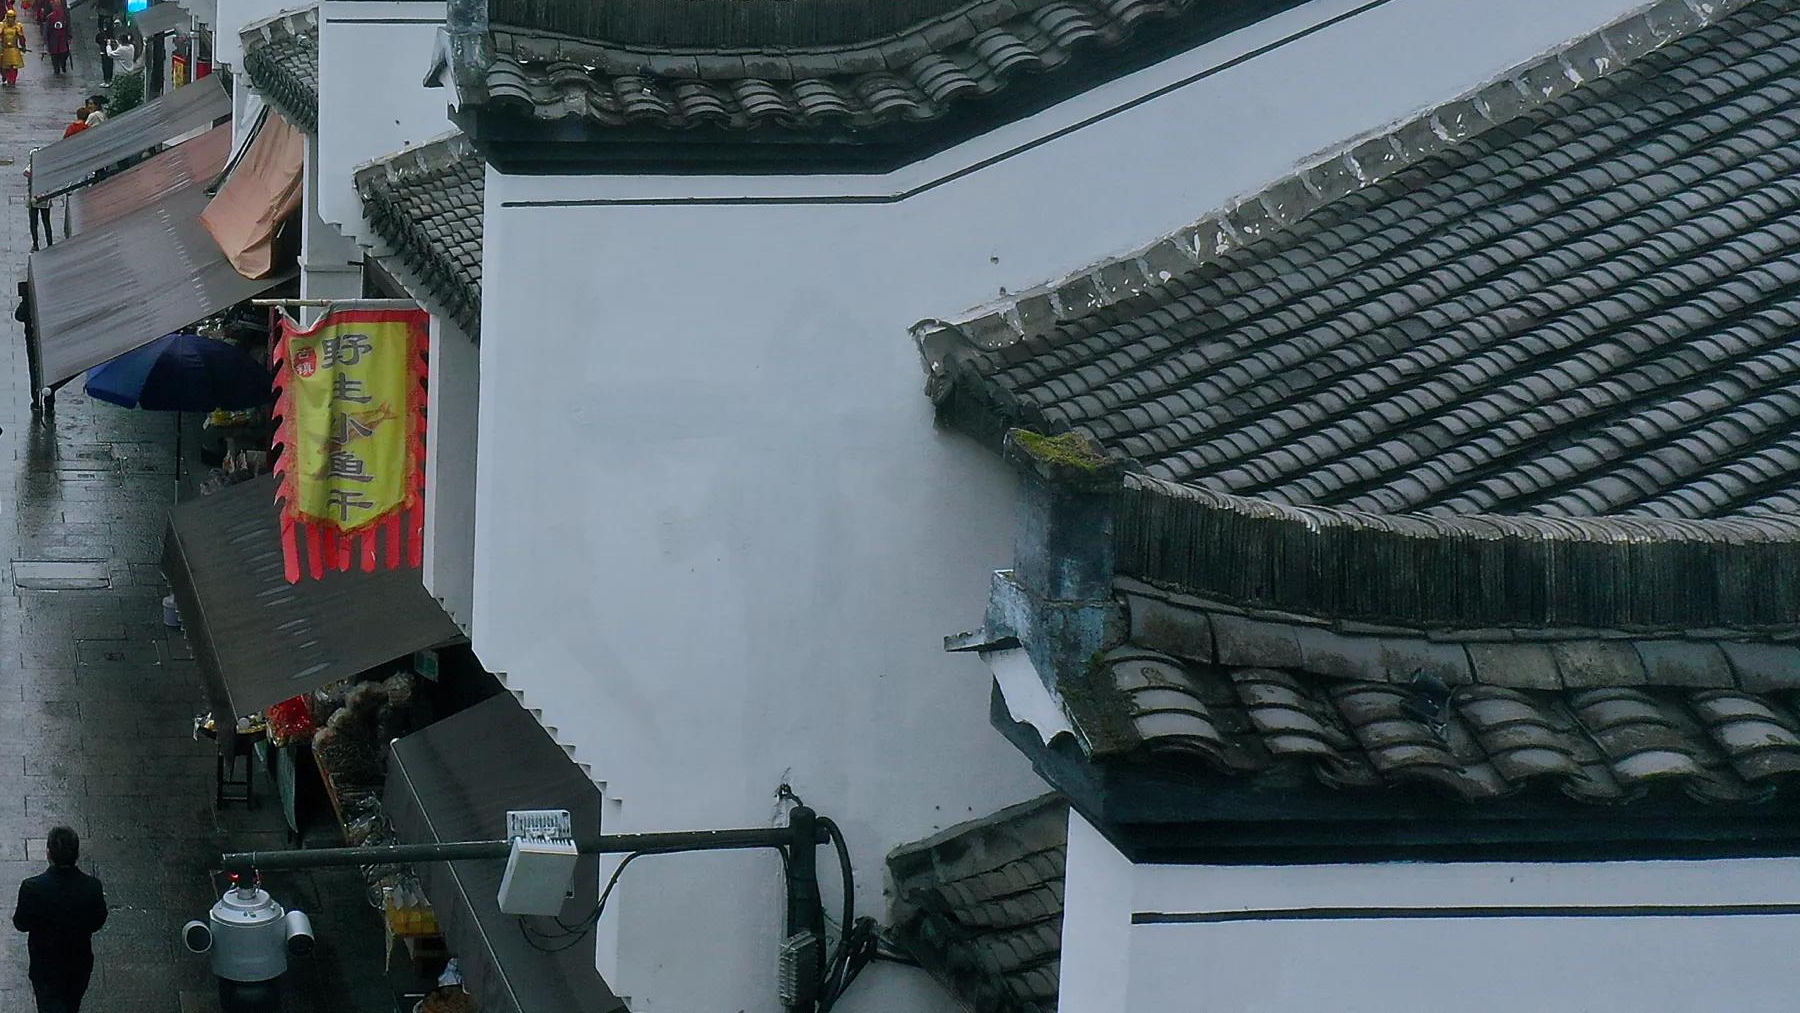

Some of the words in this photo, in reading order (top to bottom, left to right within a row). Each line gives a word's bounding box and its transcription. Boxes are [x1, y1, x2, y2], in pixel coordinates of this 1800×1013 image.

[321, 334, 374, 523] 野生小鱼干
